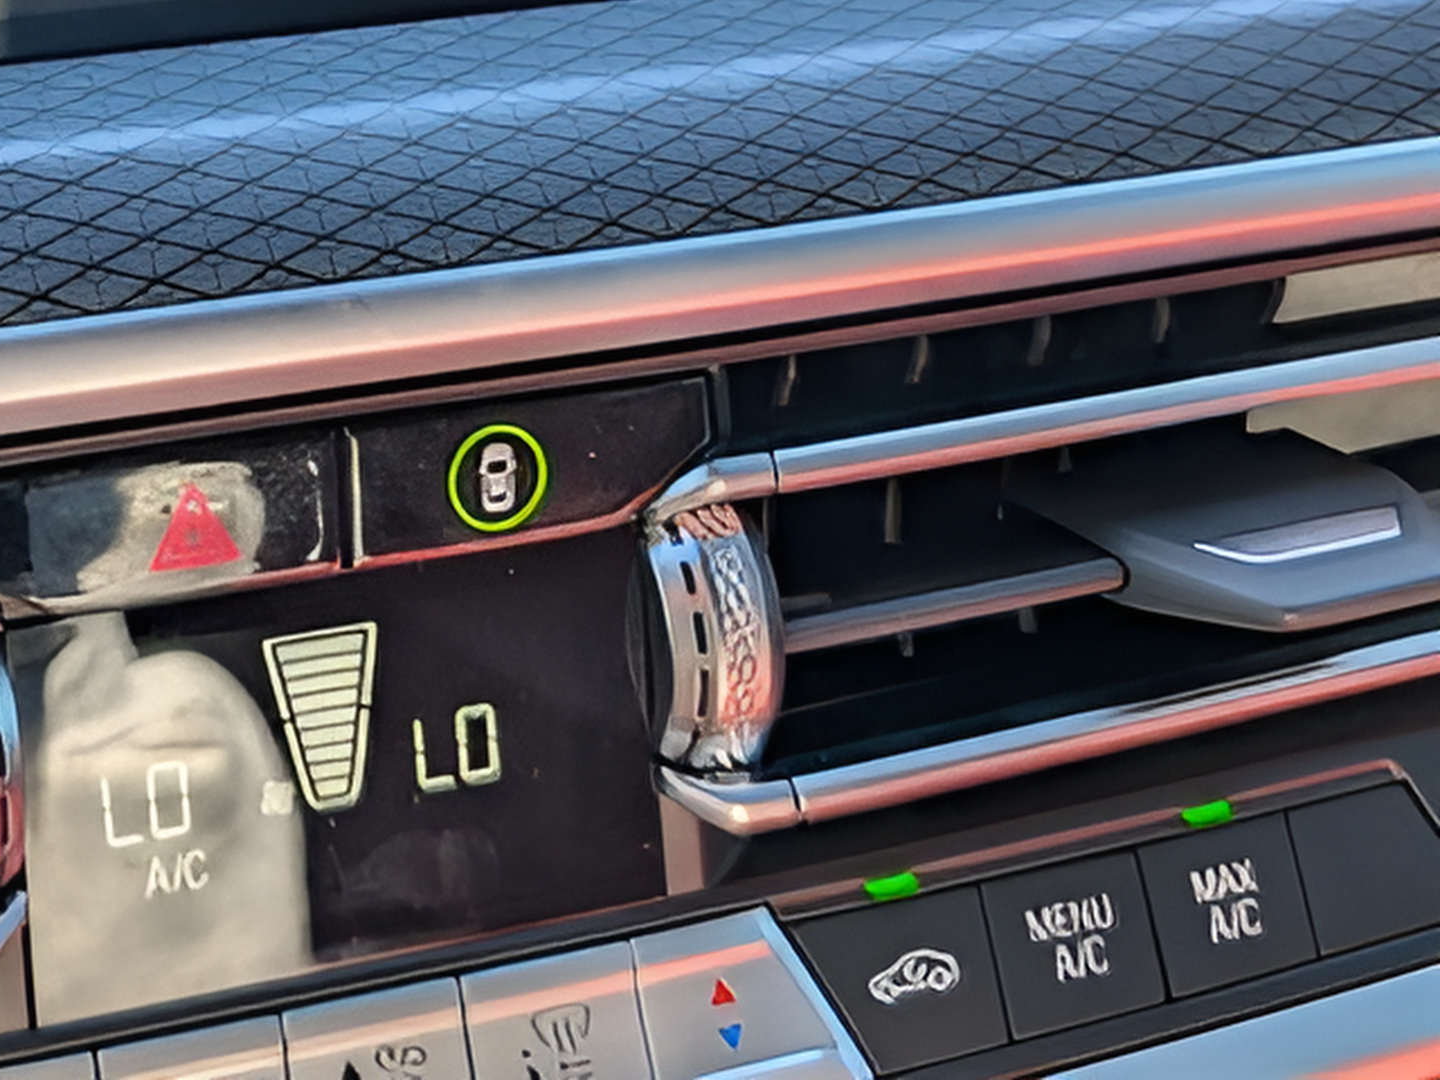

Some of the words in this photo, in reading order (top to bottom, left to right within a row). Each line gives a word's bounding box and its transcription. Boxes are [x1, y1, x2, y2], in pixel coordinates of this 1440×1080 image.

[144, 848, 210, 899] A/C
[1190, 858, 1259, 904] MAX
[1024, 893, 1116, 942] MENU
[1209, 898, 1264, 945] A/C
[1055, 934, 1113, 983] A/C
